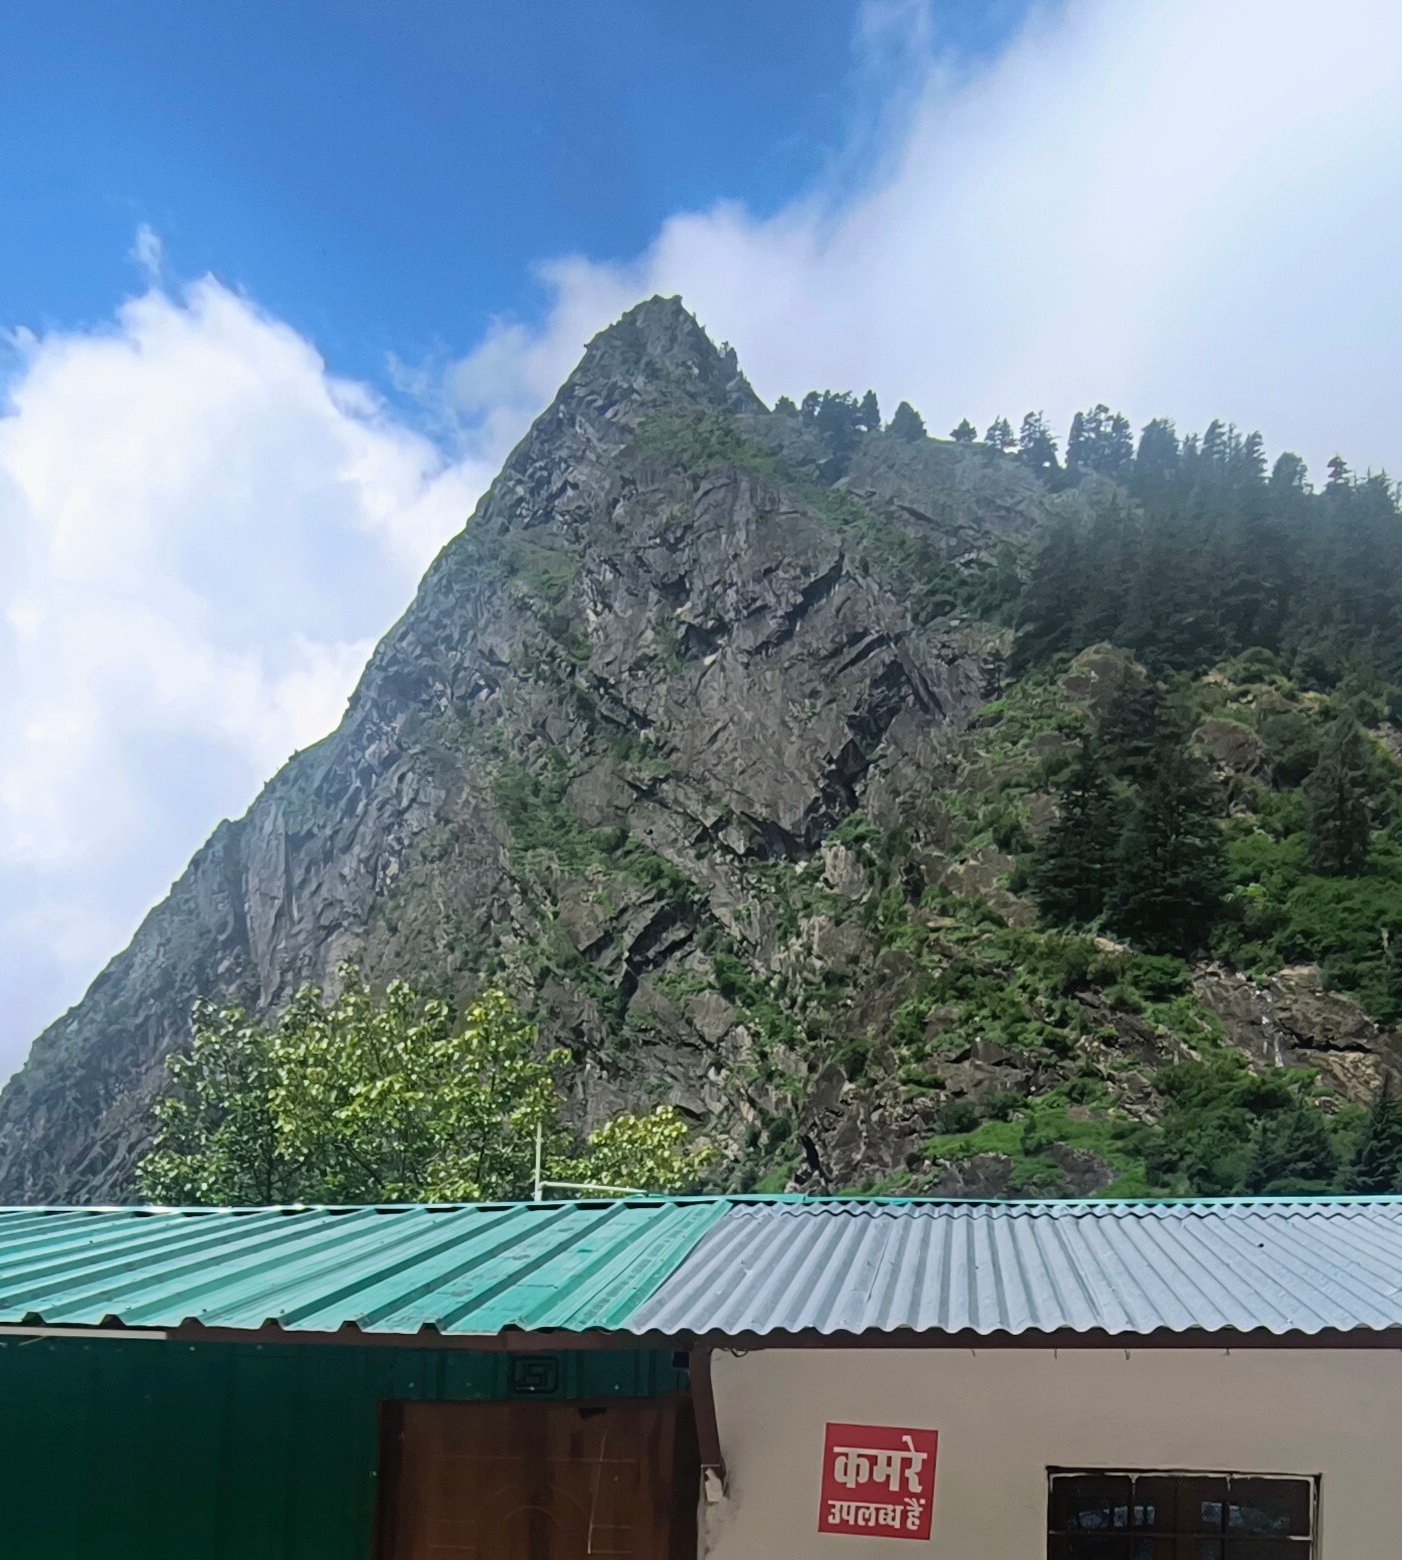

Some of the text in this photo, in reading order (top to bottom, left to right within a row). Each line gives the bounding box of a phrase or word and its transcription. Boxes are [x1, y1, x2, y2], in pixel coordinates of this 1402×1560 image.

[833, 1435, 928, 1493] कमरे
[828, 1498, 926, 1530] उपलब्ध हैं
